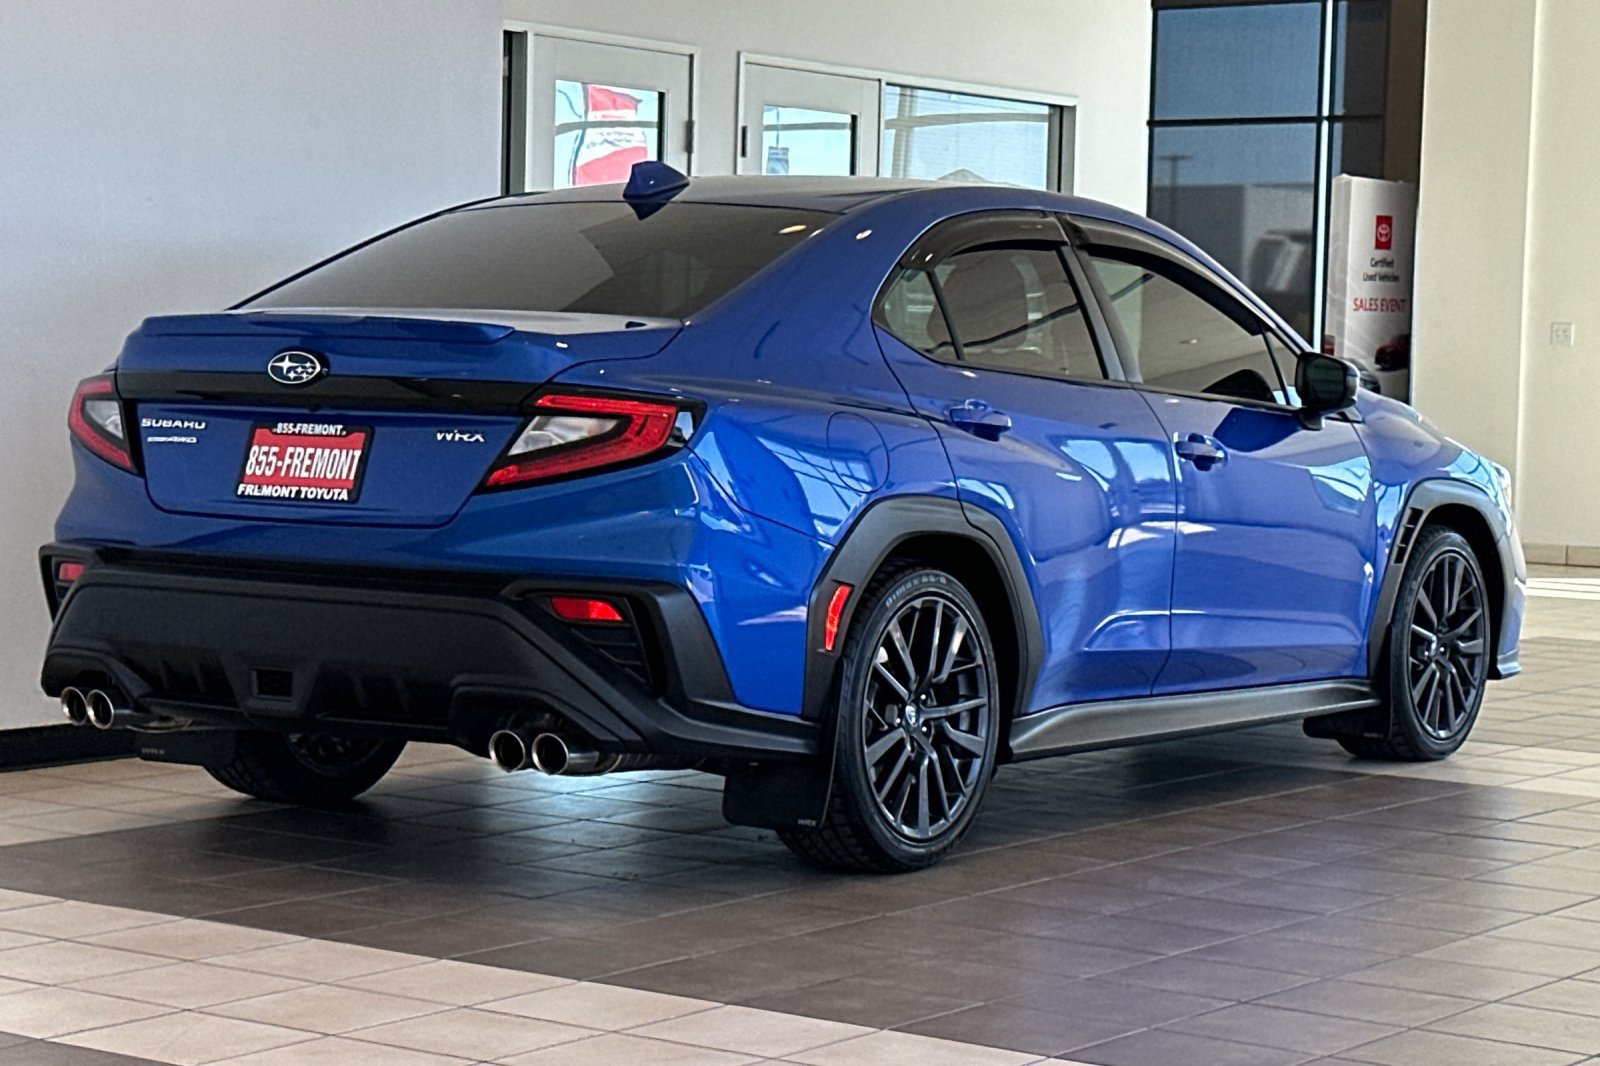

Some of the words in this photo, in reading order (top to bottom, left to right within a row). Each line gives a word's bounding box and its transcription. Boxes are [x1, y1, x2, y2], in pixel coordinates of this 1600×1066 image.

[1370, 257, 1395, 268] Certified
[1363, 272, 1377, 282] Used
[1353, 298, 1379, 312] SALES
[1380, 298, 1407, 313] EVENT
[141, 418, 206, 430] SUBARU
[436, 430, 485, 442] WRX
[245, 445, 361, 480] 855-FREMONT
[237, 483, 299, 499] FREMONT
